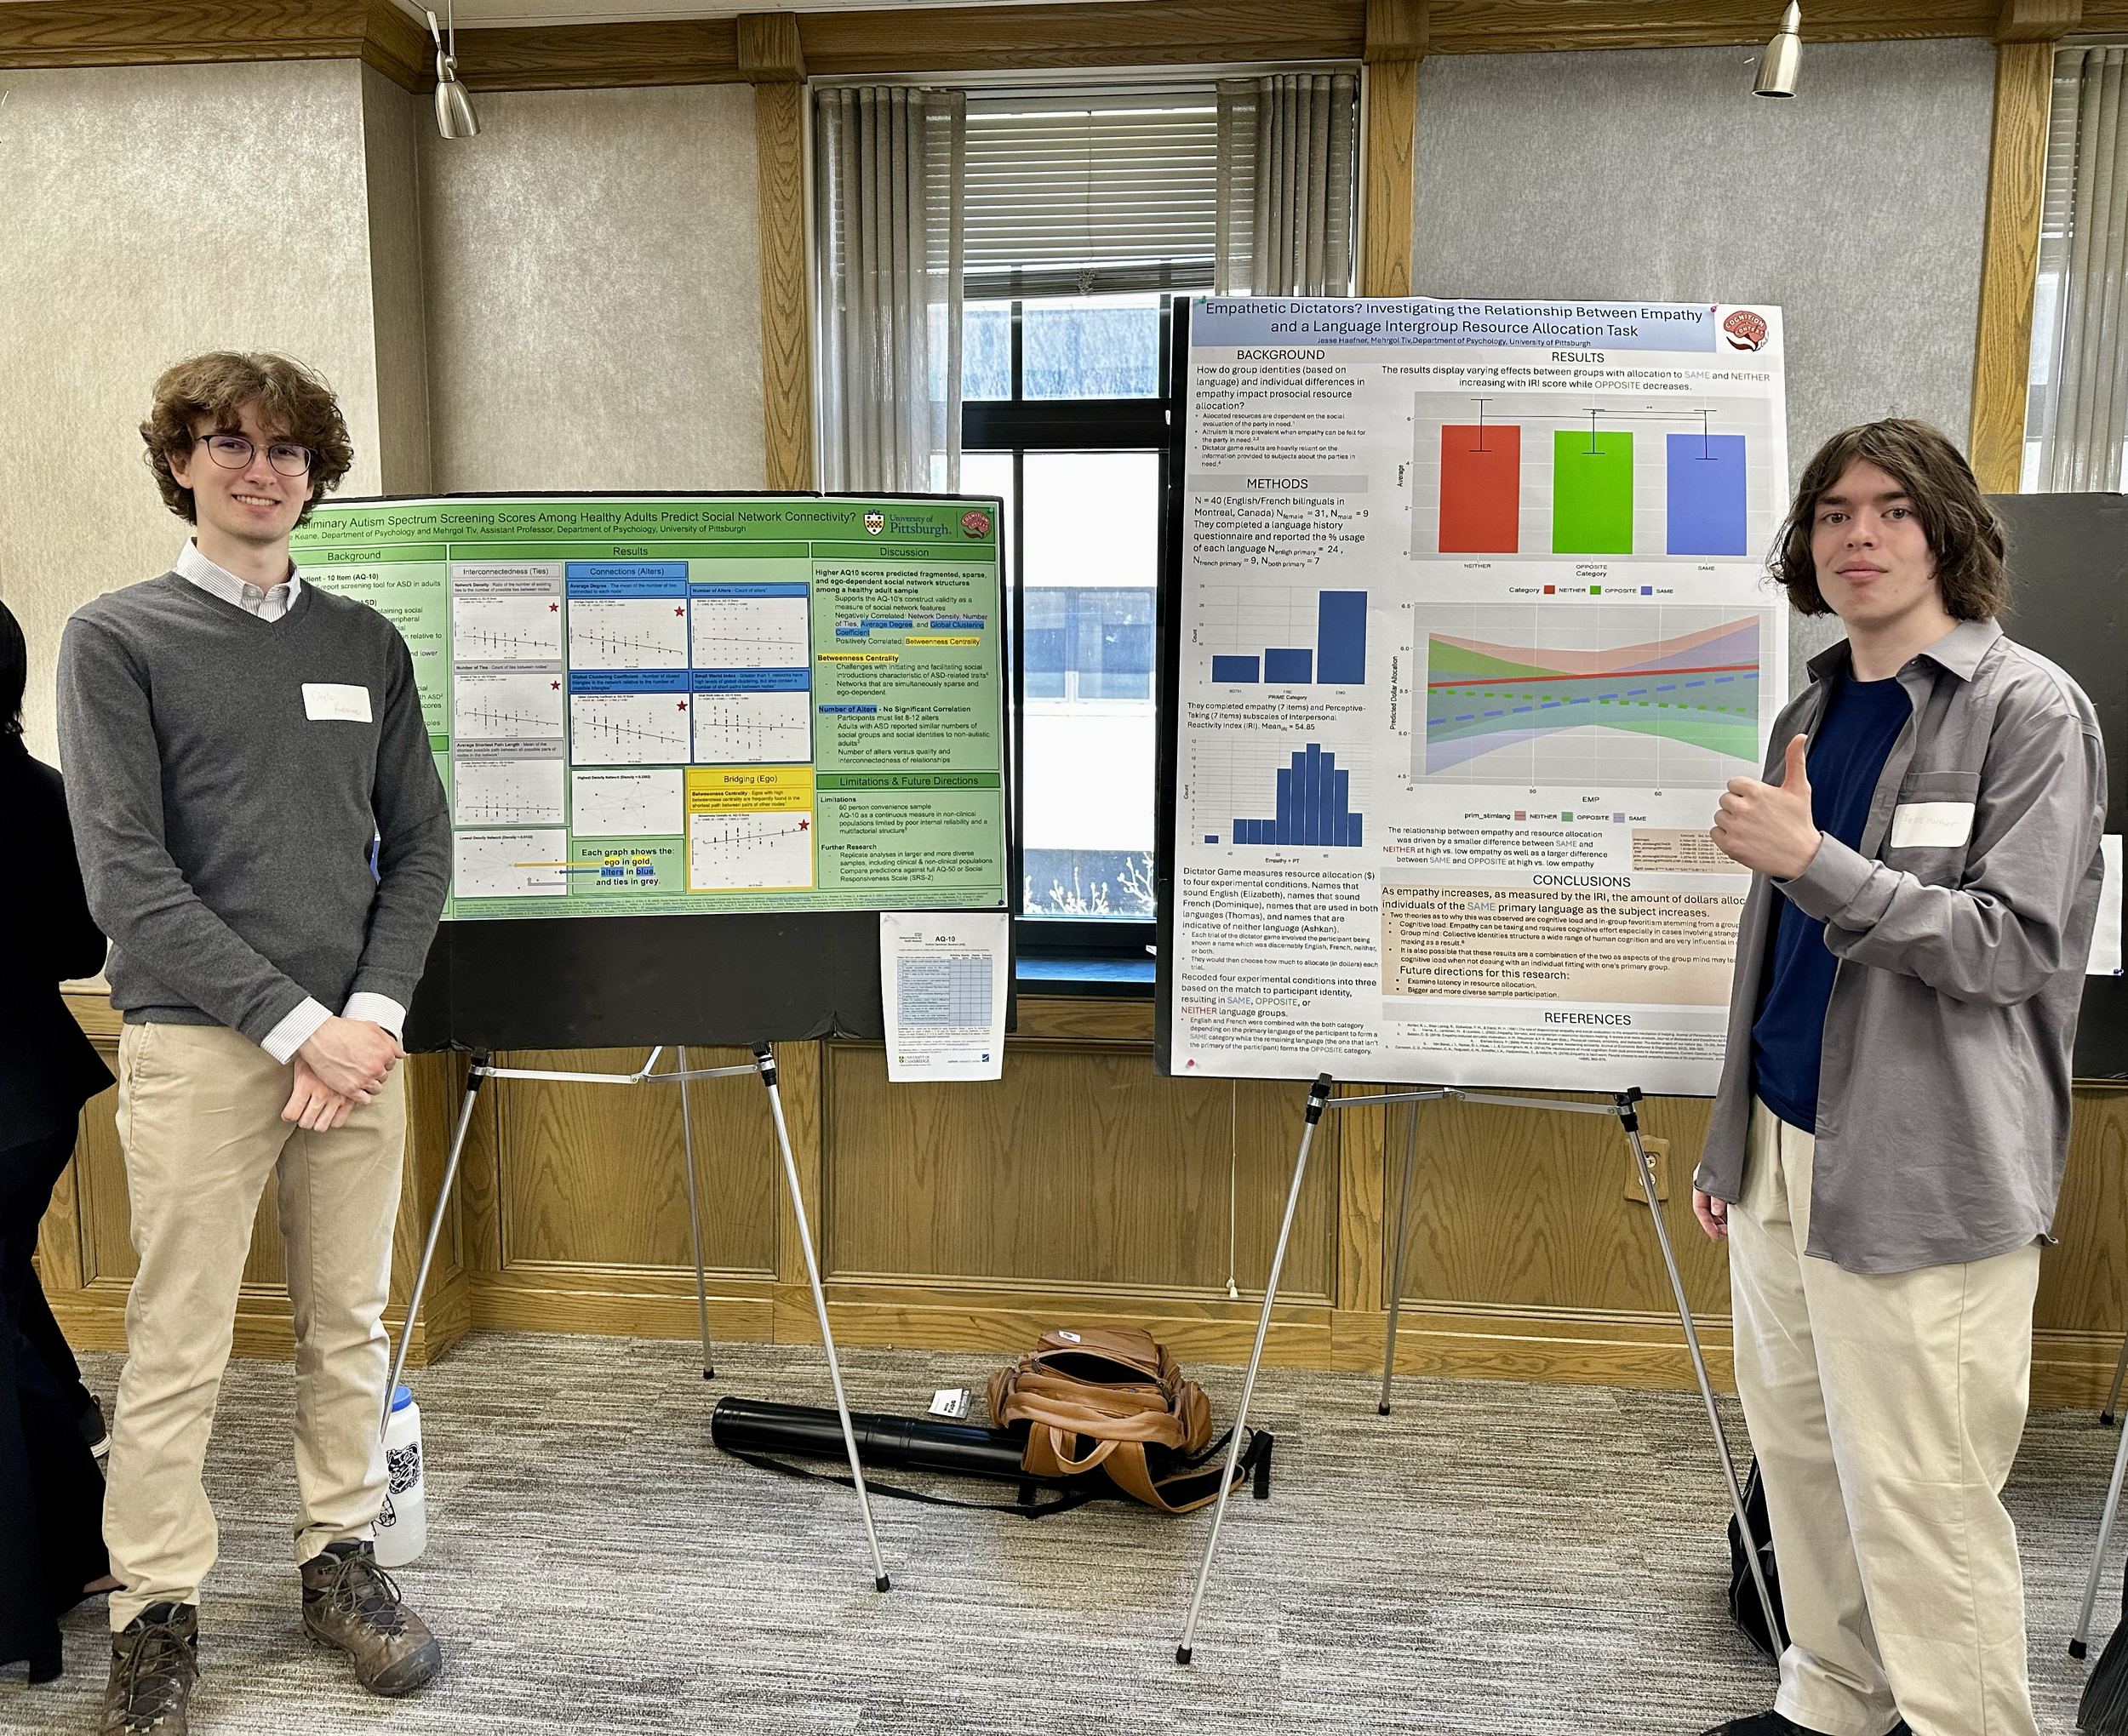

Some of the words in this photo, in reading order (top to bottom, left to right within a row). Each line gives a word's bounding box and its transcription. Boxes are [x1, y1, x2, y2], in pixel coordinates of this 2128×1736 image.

[1206, 302, 1285, 316] Empathetic
[1290, 302, 1362, 314] Dictators?
[1366, 302, 1455, 317] Investigating
[1457, 305, 1480, 315] the
[1484, 305, 1572, 319] Relationship
[1576, 306, 1637, 318] Between
[1641, 308, 1702, 323] Empathy
[1725, 314, 1765, 328] COGNITION
[1271, 320, 1296, 332] and
[1301, 323, 1309, 332] a
[1313, 320, 1381, 334] Language
[1386, 320, 1458, 334] Intergroup
[1462, 320, 1529, 334] Resource
[1532, 323, 1603, 335] Allocation
[1606, 324, 1638, 336] Task
[1735, 326, 1764, 335] CONTEXT
[1370, 337, 1399, 345] Mehrgol
[1401, 336, 1456, 345] Tiv,Department
[1509, 338, 1545, 347] University
[1554, 339, 1591, 348] Pittsburgh
[1237, 349, 1324, 360] BACKGROUND
[1552, 351, 1605, 363] RESULTS
[1218, 365, 1230, 374] do
[1232, 366, 1257, 375] group
[1302, 365, 1333, 375] (based
[1381, 365, 1398, 374] The
[1432, 366, 1465, 375] display
[1466, 366, 1499, 376] varying
[1500, 366, 1530, 375] effects
[1533, 367, 1571, 375] between
[1573, 369, 1604, 378] groups
[1627, 369, 1672, 378] allocation
[1685, 371, 1710, 380] SAME
[1459, 380, 1505, 388] increasing
[1507, 379, 1525, 387] with
[1528, 379, 1540, 387] IRI
[1568, 380, 1593, 388] while
[1594, 380, 1640, 389] OPPOSITE
[1247, 478, 1307, 488] METHODS
[349, 517, 385, 528] Autism
[387, 515, 437, 527] Spectrum
[440, 513, 495, 525] Screening
[497, 512, 535, 523] Scores
[538, 512, 576, 524] Among
[581, 511, 621, 524] Healthy
[623, 511, 657, 522] Adults
[661, 511, 699, 522] Predict
[701, 511, 734, 522] Social
[738, 511, 781, 522] Network
[785, 511, 856, 524] Connectivity?
[890, 514, 925, 524] University
[321, 531, 364, 540] Department
[375, 528, 415, 538] Psychology
[432, 526, 463, 535] Mehrgol
[465, 526, 478, 534] Tiv,
[516, 525, 555, 534] Professor,
[557, 525, 602, 534] Department
[613, 525, 657, 534] Psychology,
[660, 525, 697, 534] University
[698, 524, 706, 533] of
[708, 524, 746, 534] Pittsburgh
[890, 522, 952, 538] Pittsburgh.
[613, 546, 649, 556] Results
[879, 547, 929, 557] Discussion
[327, 551, 380, 562] Background
[638, 568, 664, 576] (Alters)
[919, 570, 960, 579] fragmented,
[847, 586, 873, 595] healthy
[865, 654, 899, 663] Centrality
[724, 775, 754, 784] Bridging
[756, 774, 777, 784] (Ego)
[839, 777, 889, 785] Limitations
[891, 776, 899, 785] &
[901, 776, 931, 785] Future
[933, 776, 979, 785] Directions
[604, 848, 628, 857] graph
[604, 859, 621, 868] ego
[632, 858, 652, 867] gold,
[636, 867, 655, 876] blue,
[640, 878, 661, 887] grey.
[1532, 874, 1631, 888] CONCLUSIONS
[1399, 965, 1432, 974] Future
[1433, 967, 1483, 977] directions
[1485, 968, 1500, 977] for
[1502, 968, 1520, 978] this
[1522, 971, 1570, 979] research:
[1544, 1012, 1631, 1025] REFERENCES
